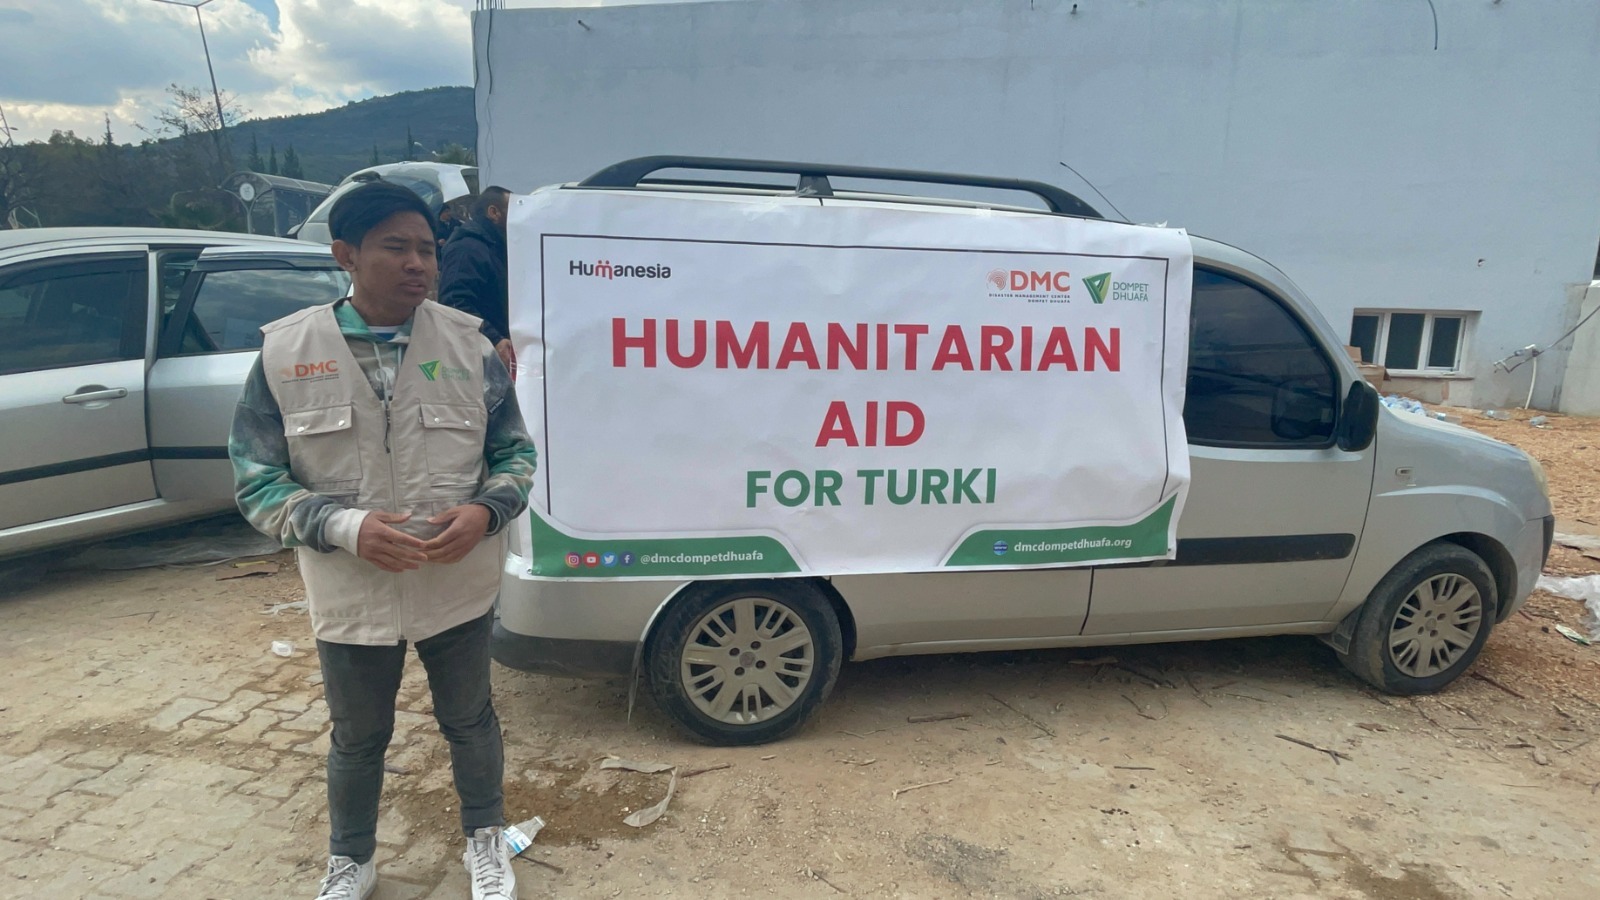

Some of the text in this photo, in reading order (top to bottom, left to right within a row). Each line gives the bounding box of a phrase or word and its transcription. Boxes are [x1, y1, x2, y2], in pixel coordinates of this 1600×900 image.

[569, 260, 672, 280] Humanesia
[1010, 270, 1070, 292] DMC
[1113, 281, 1149, 292] DOMPET
[1113, 292, 1149, 302] DHUAFA
[612, 317, 1121, 372] HUMANITARIAN
[294, 360, 339, 378] DMC
[814, 400, 926, 447] AID
[746, 468, 997, 508] FOR TURKI
[1014, 537, 1132, 553] dmcdompetdhuafa.org
[640, 550, 763, 565] @dmcdompetdhuafa
